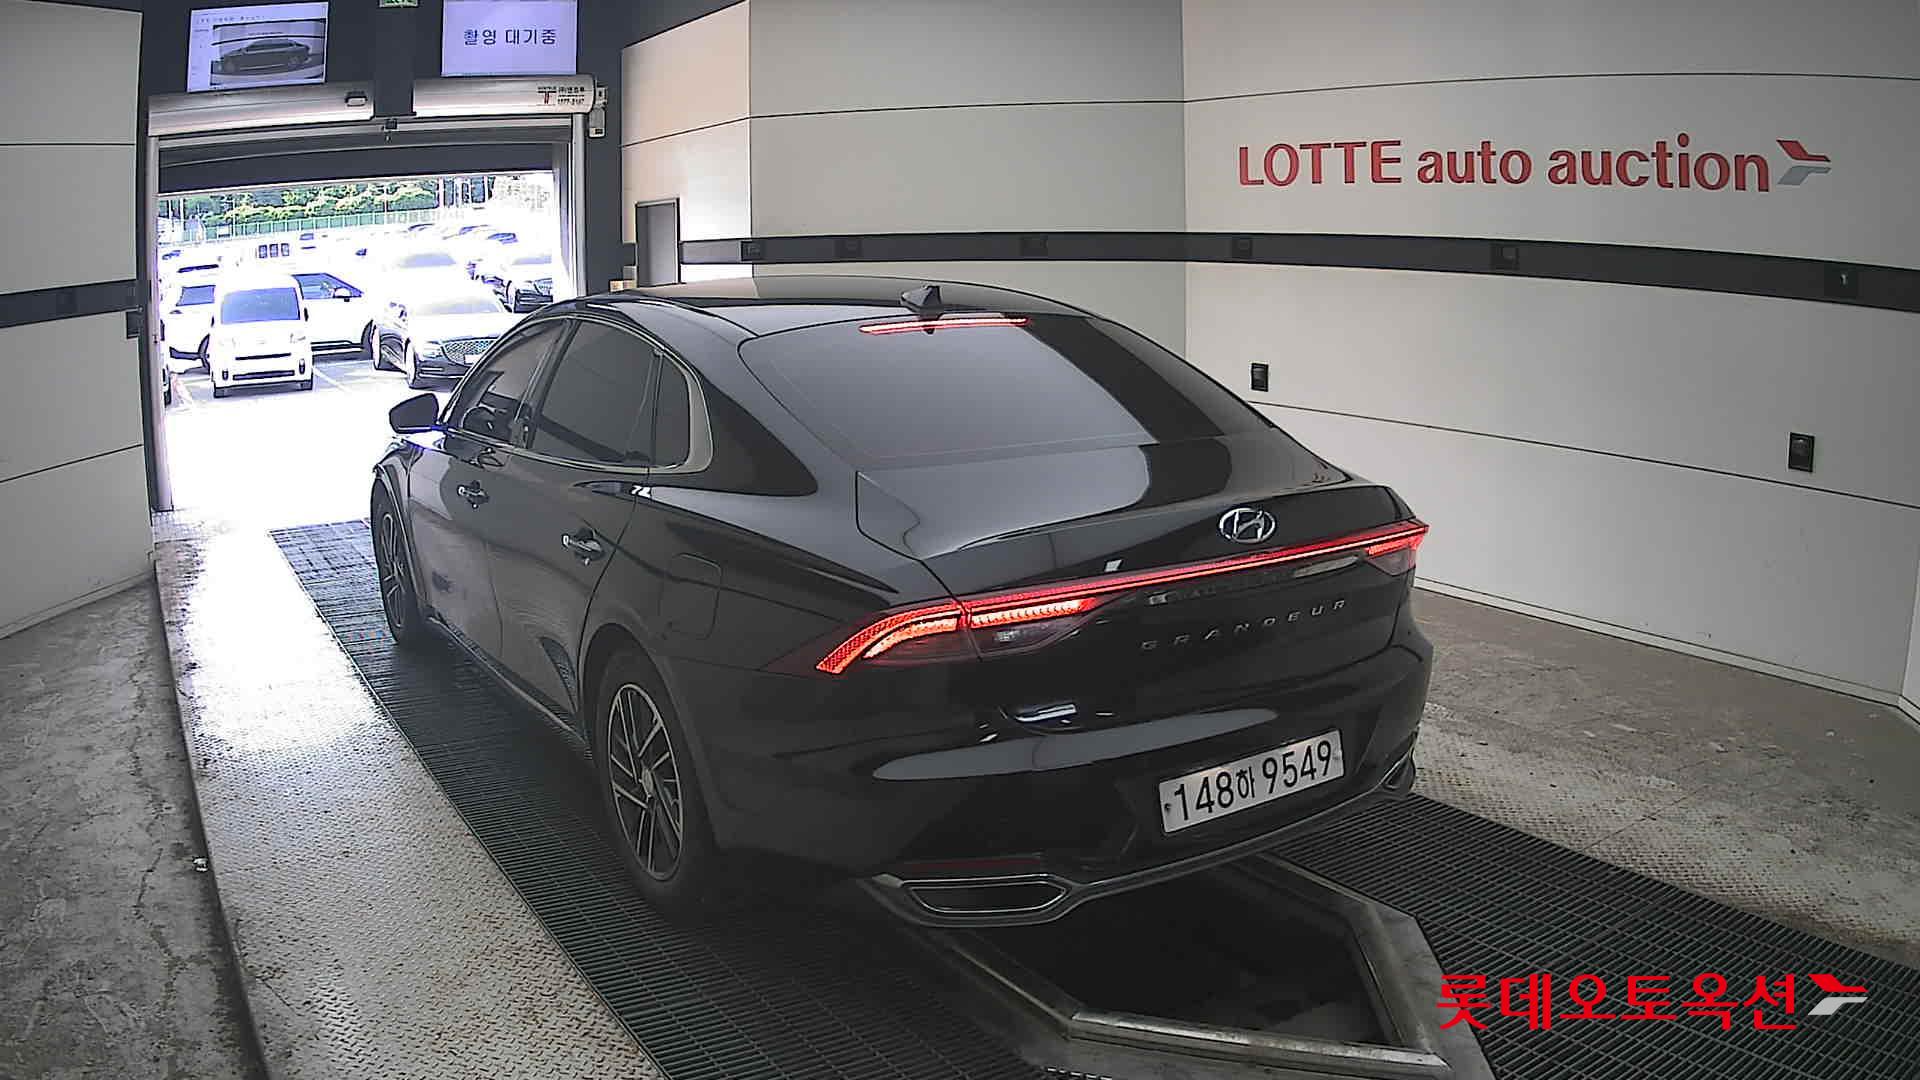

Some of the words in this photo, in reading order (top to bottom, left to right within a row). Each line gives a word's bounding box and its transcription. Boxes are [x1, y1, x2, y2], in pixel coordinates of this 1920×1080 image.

[463, 28, 497, 46] 촬영
[504, 28, 557, 45] 대기중
[1238, 139, 1402, 187] LOTTE
[1416, 140, 1532, 185] auto
[1547, 133, 1771, 193] auction
[1140, 599, 1346, 650] GRANDEUR
[1174, 766, 1256, 821] 148하
[1262, 740, 1332, 794] 9549
